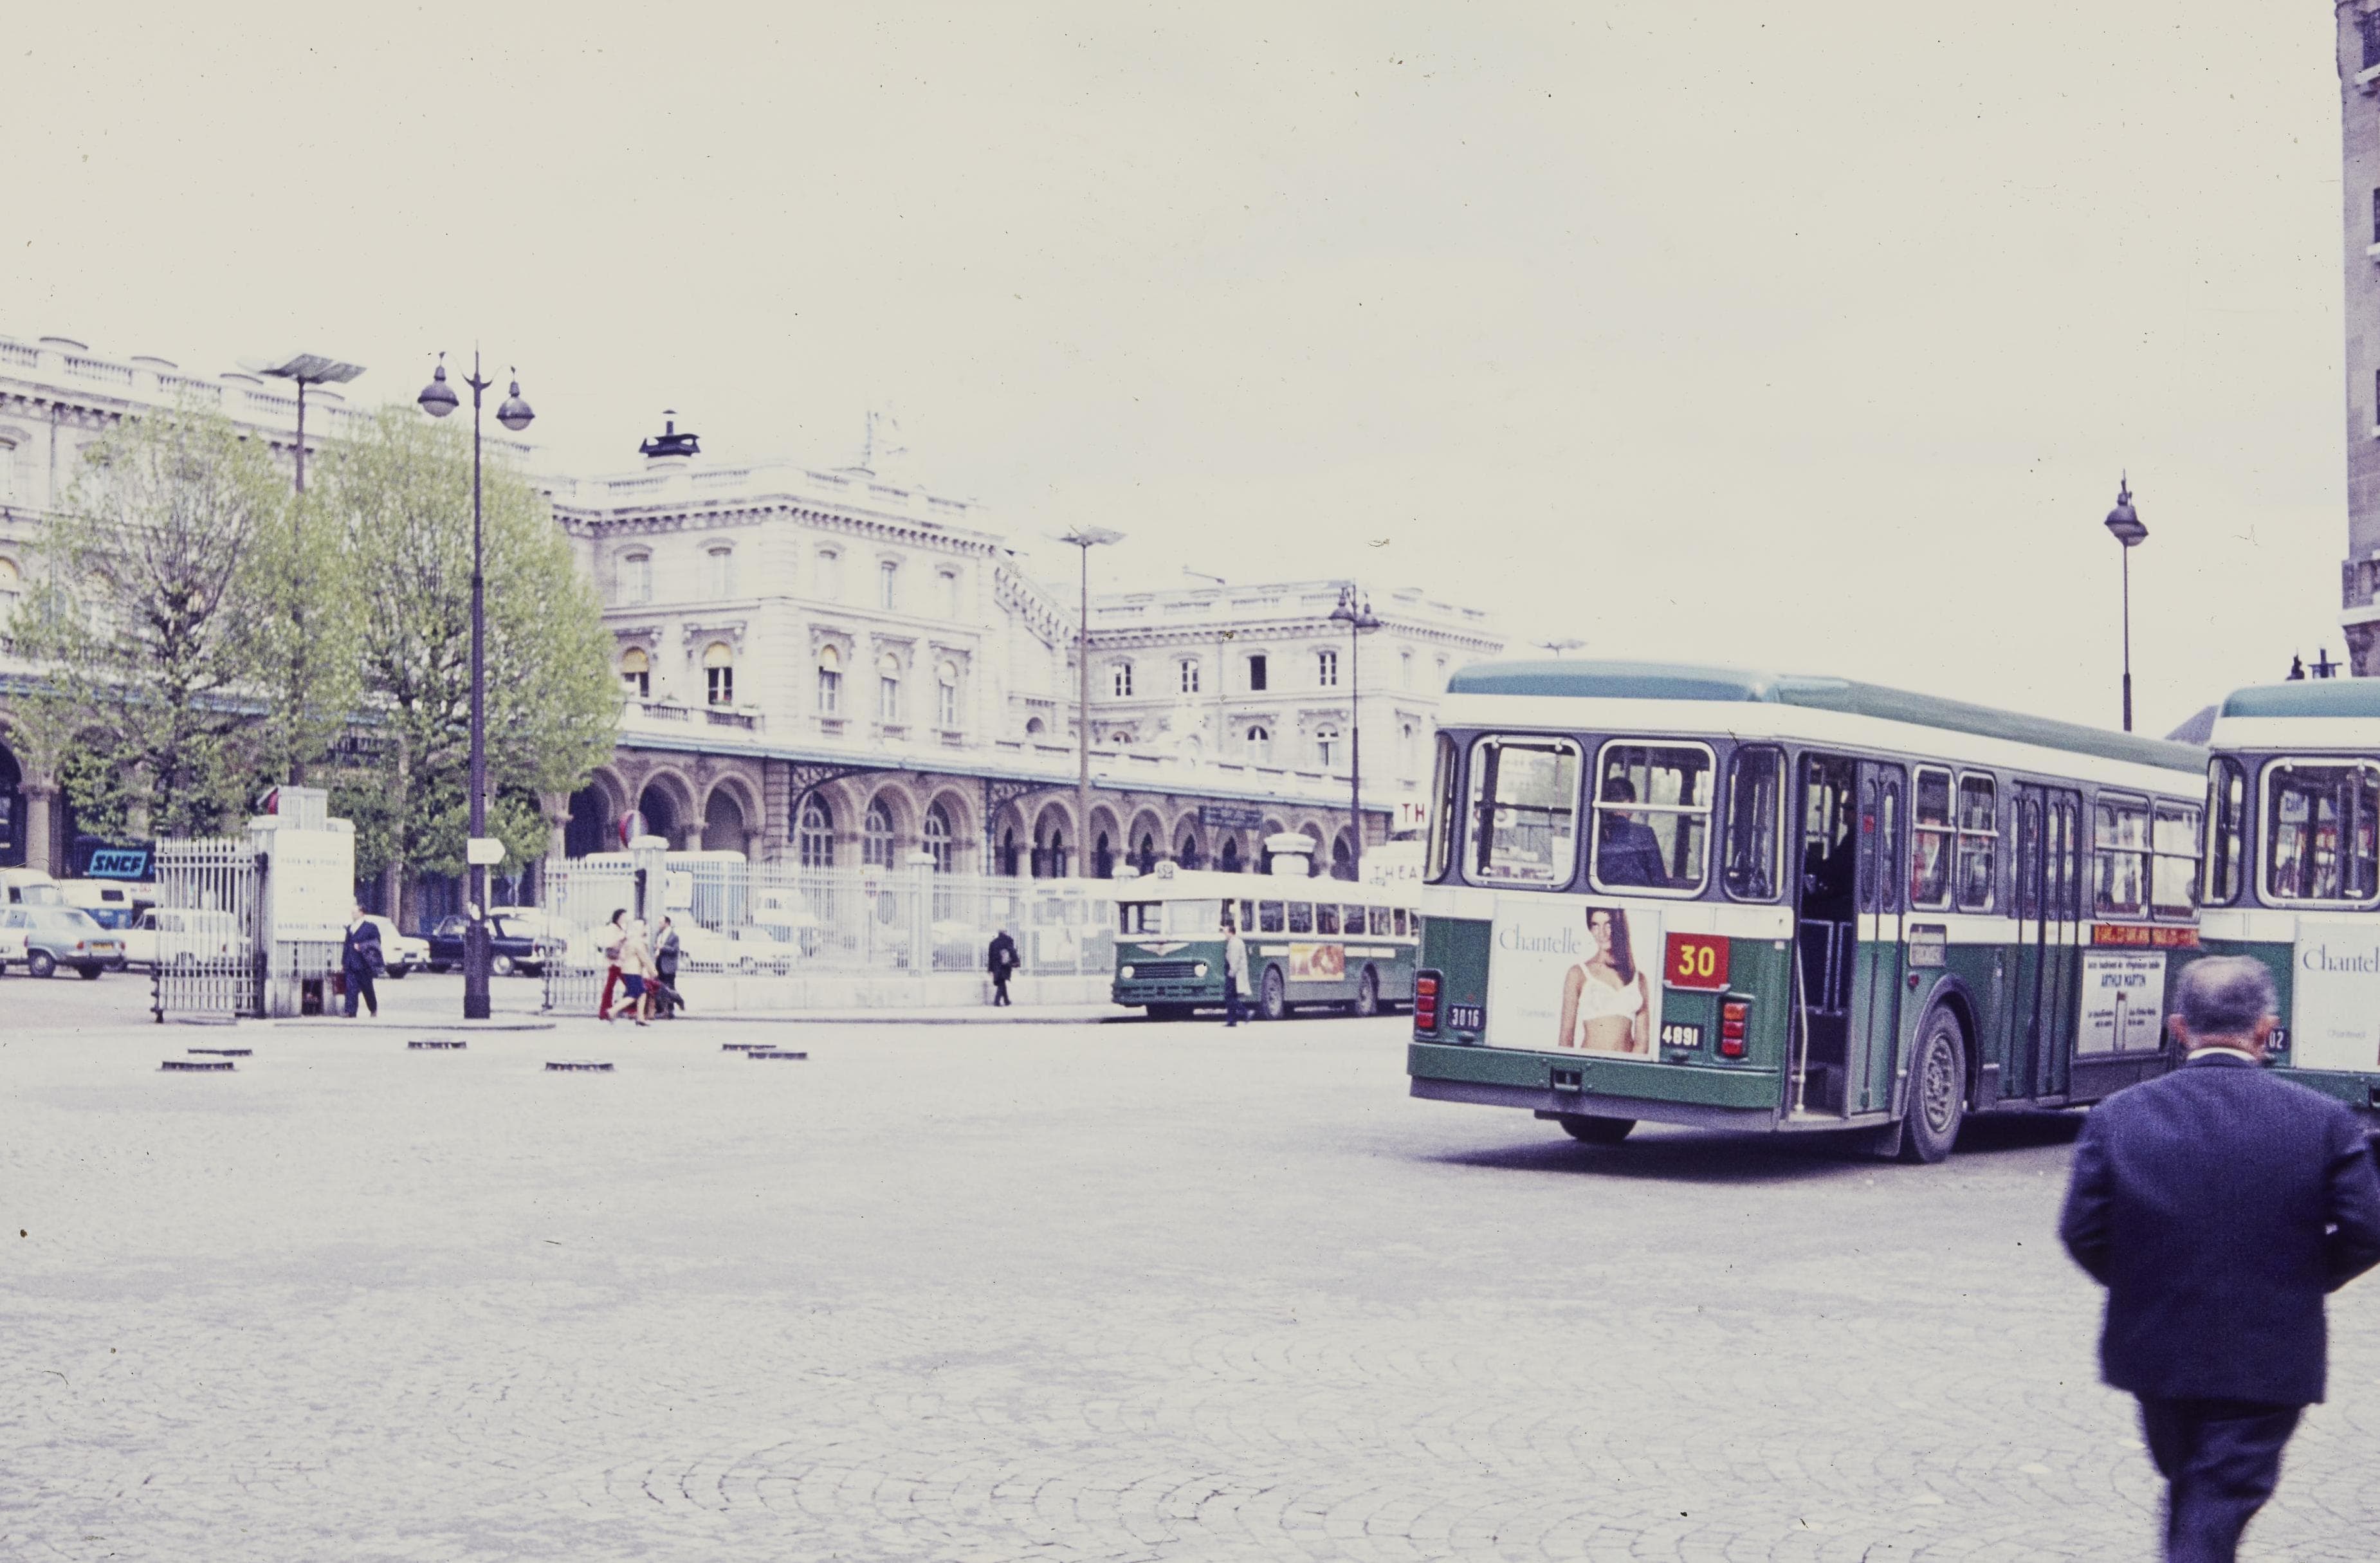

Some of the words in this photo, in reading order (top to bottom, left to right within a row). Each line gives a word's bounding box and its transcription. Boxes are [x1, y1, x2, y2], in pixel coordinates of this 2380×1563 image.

[93, 854, 142, 872] SNCF
[1499, 924, 1581, 955] Chantelle
[1678, 944, 1716, 977] 30
[1662, 1025, 1698, 1046] 4891
